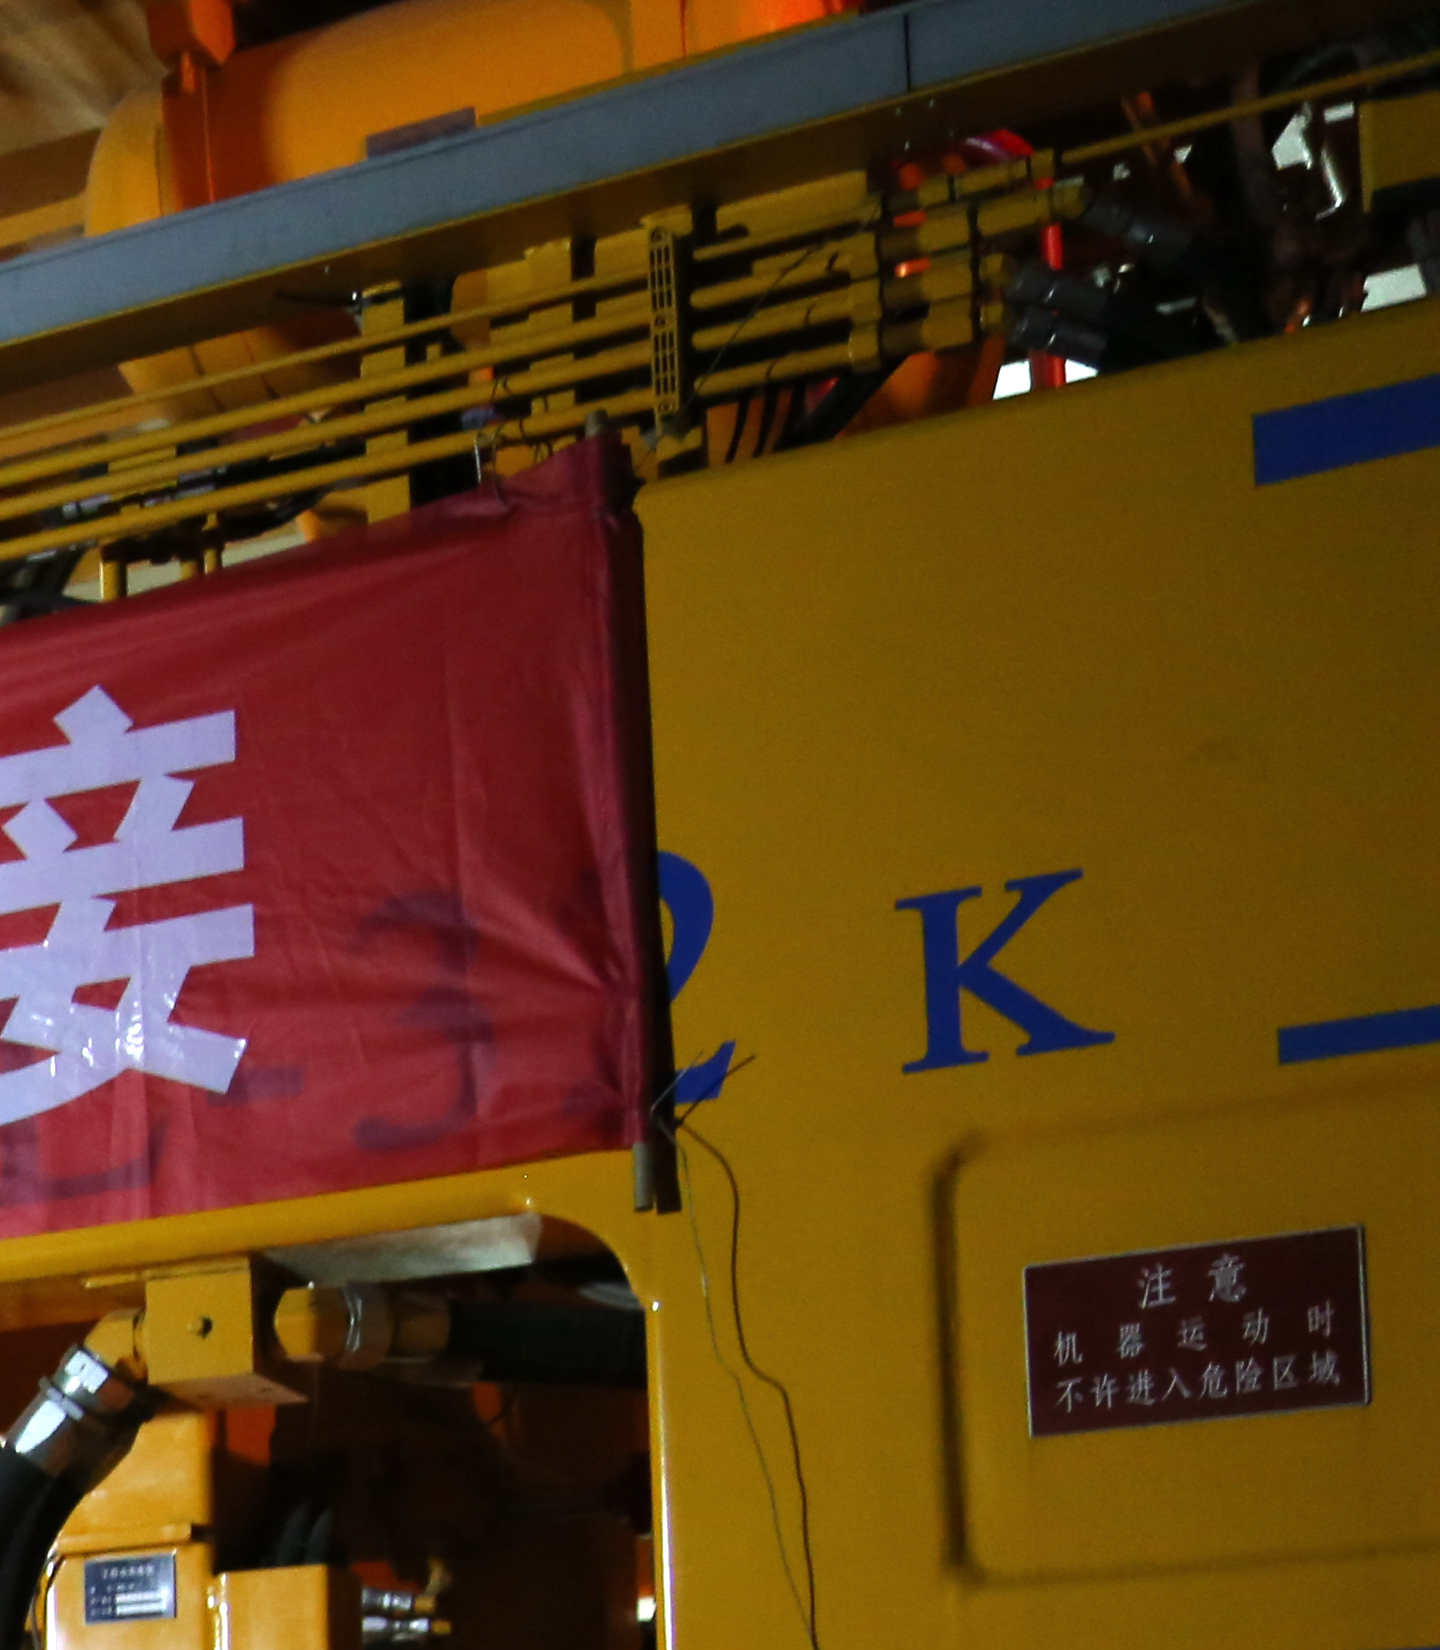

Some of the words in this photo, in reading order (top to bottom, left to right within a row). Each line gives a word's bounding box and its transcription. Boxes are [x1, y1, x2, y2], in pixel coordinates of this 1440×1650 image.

[1137, 1252, 1247, 1310] 注意
[1053, 1300, 1336, 1367] 机器运动时
[1055, 1350, 1342, 1415] 不许进入危险区域
